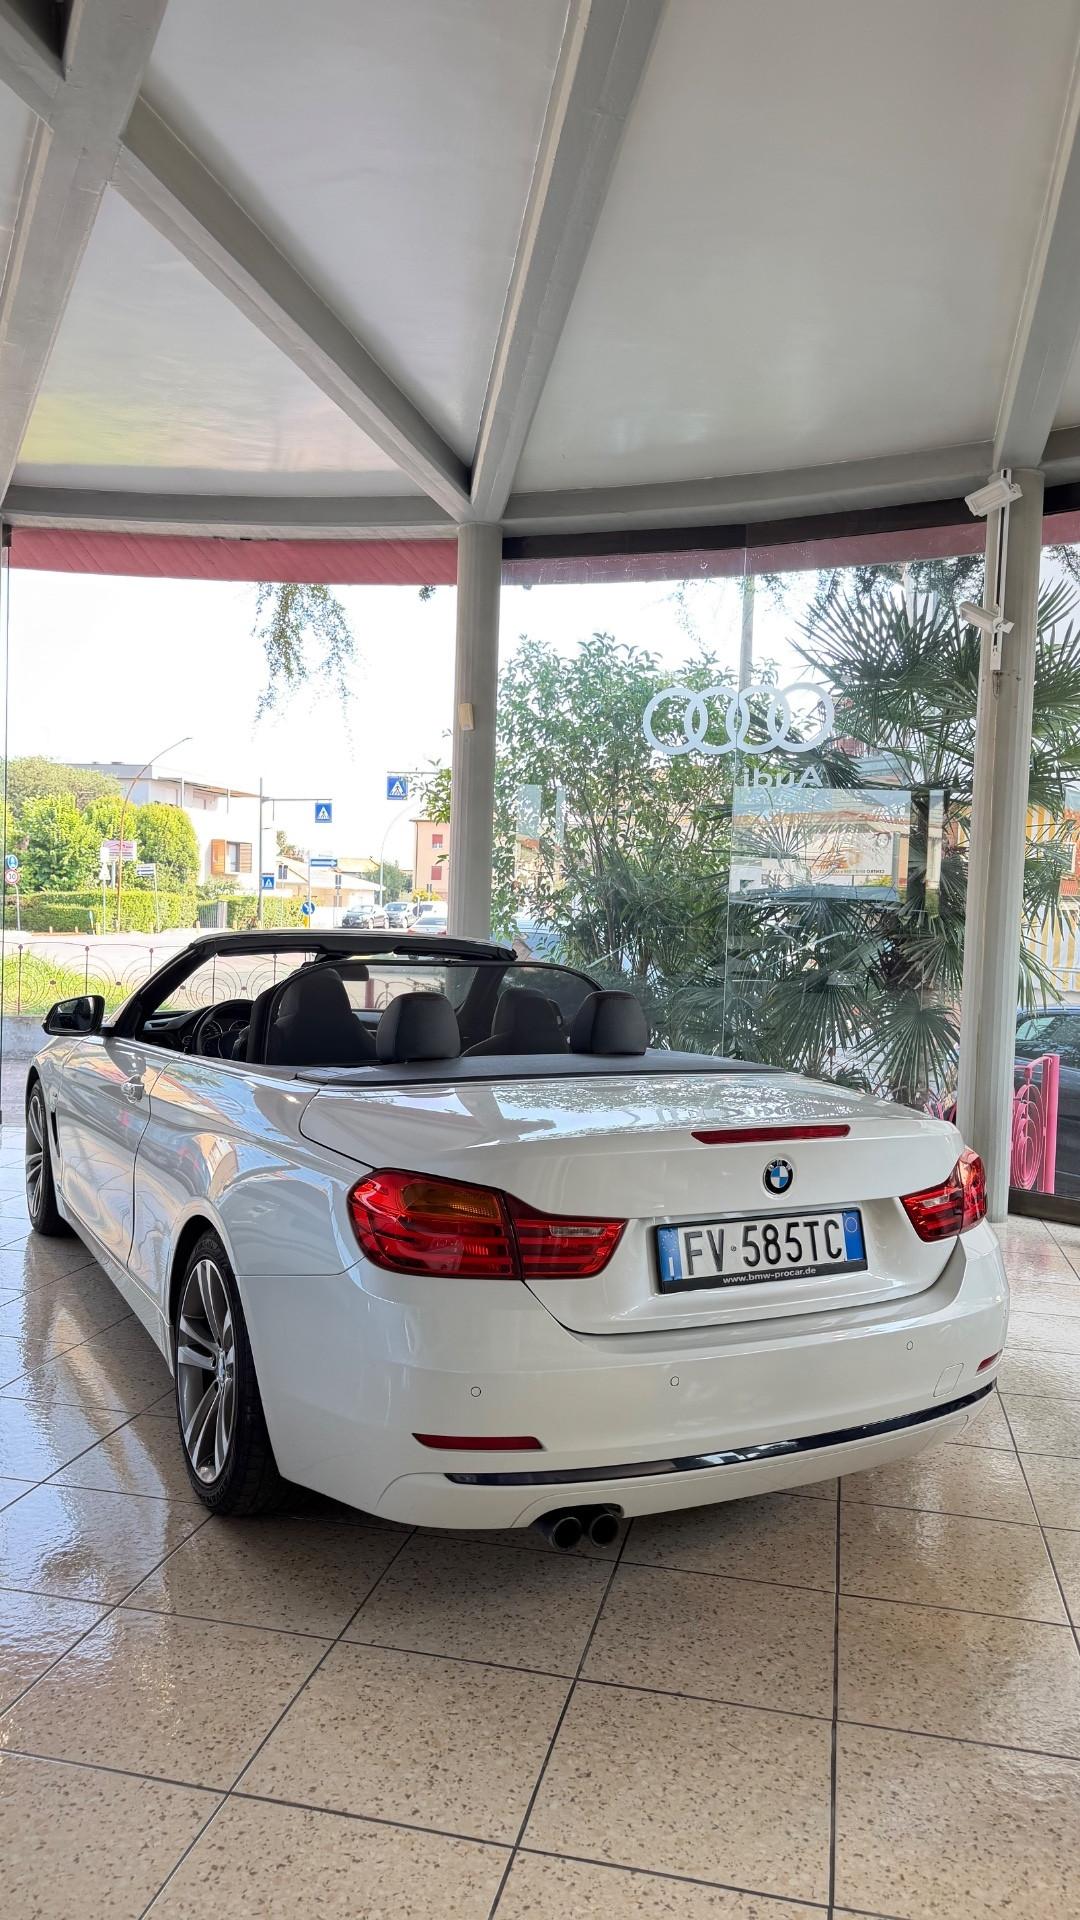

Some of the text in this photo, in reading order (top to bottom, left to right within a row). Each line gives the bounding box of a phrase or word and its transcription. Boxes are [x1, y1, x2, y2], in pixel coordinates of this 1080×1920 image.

[767, 1159, 793, 1171] BMW
[683, 1218, 842, 1276] FV 585TC
[722, 1266, 817, 1284] www.bmw-procar.de
